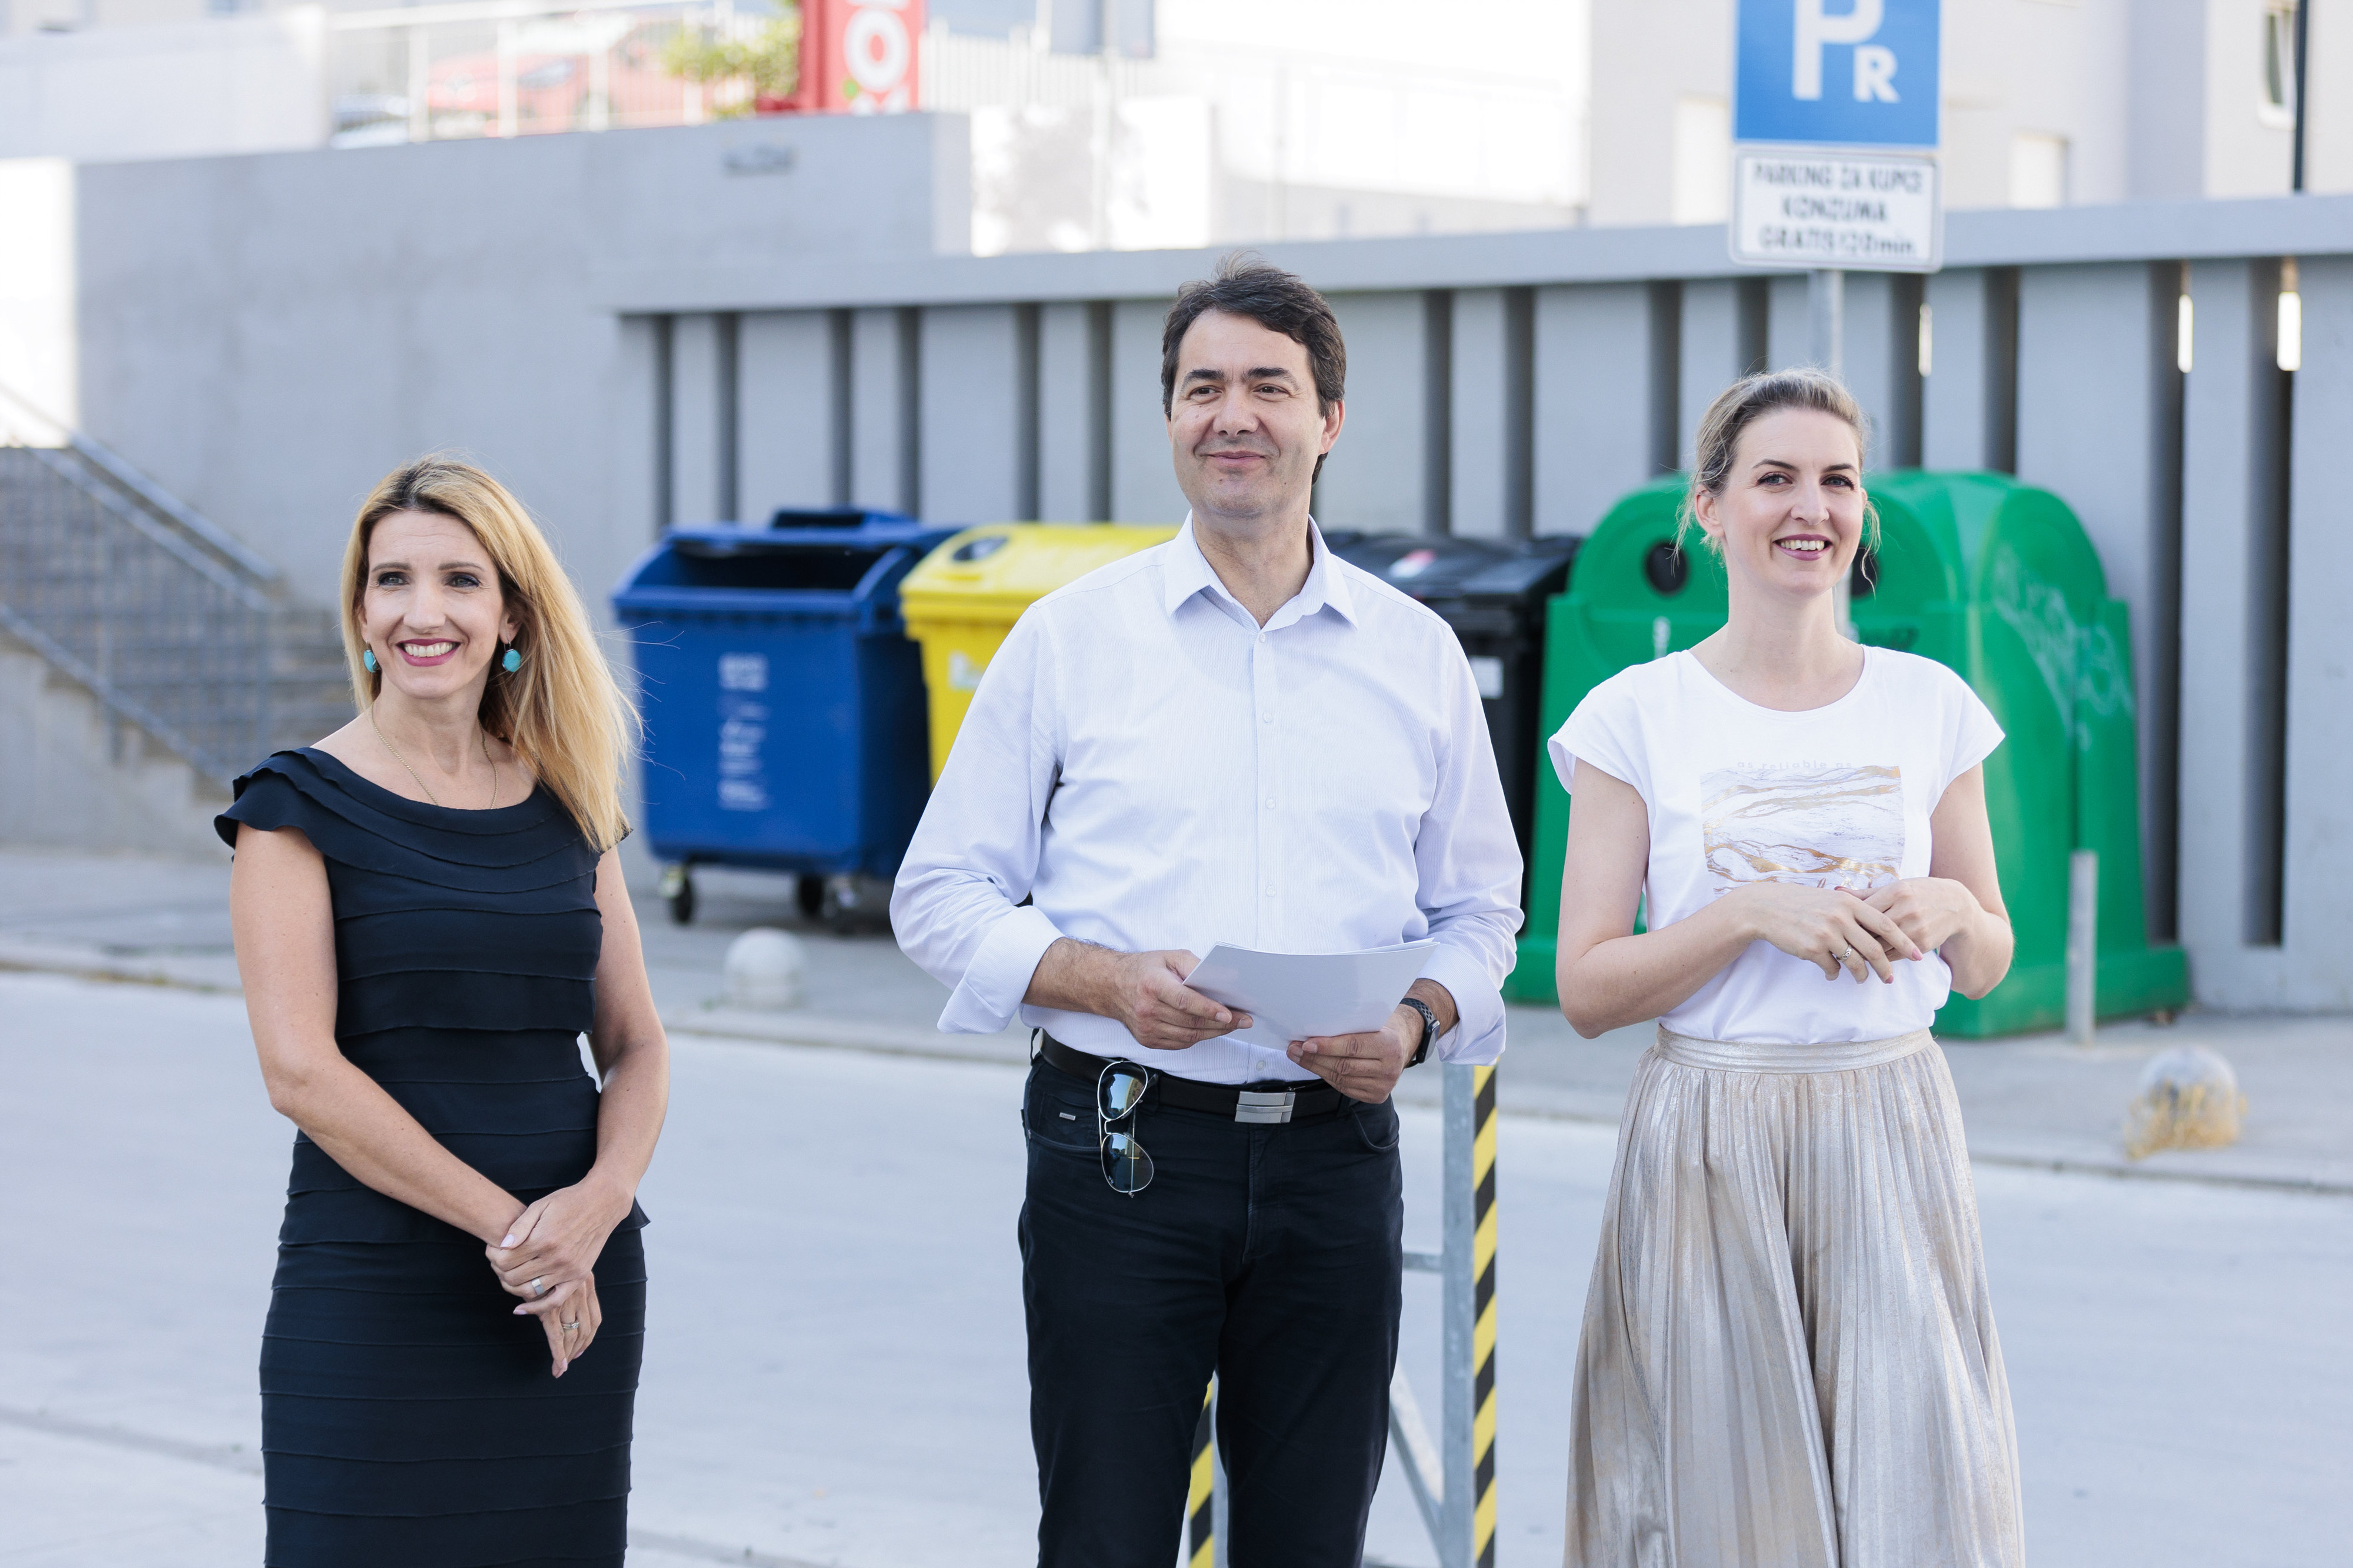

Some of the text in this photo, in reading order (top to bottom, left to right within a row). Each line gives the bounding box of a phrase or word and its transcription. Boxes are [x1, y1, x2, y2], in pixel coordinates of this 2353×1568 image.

[1792, 0, 1884, 101] P
[1853, 45, 1901, 103] R
[1755, 163, 1833, 188] PARKING
[1841, 165, 1864, 191] ZA
[1784, 195, 1889, 223] KONZUMA
[1759, 225, 1836, 253] GRATIS
[1761, 759, 1827, 770] reliable
